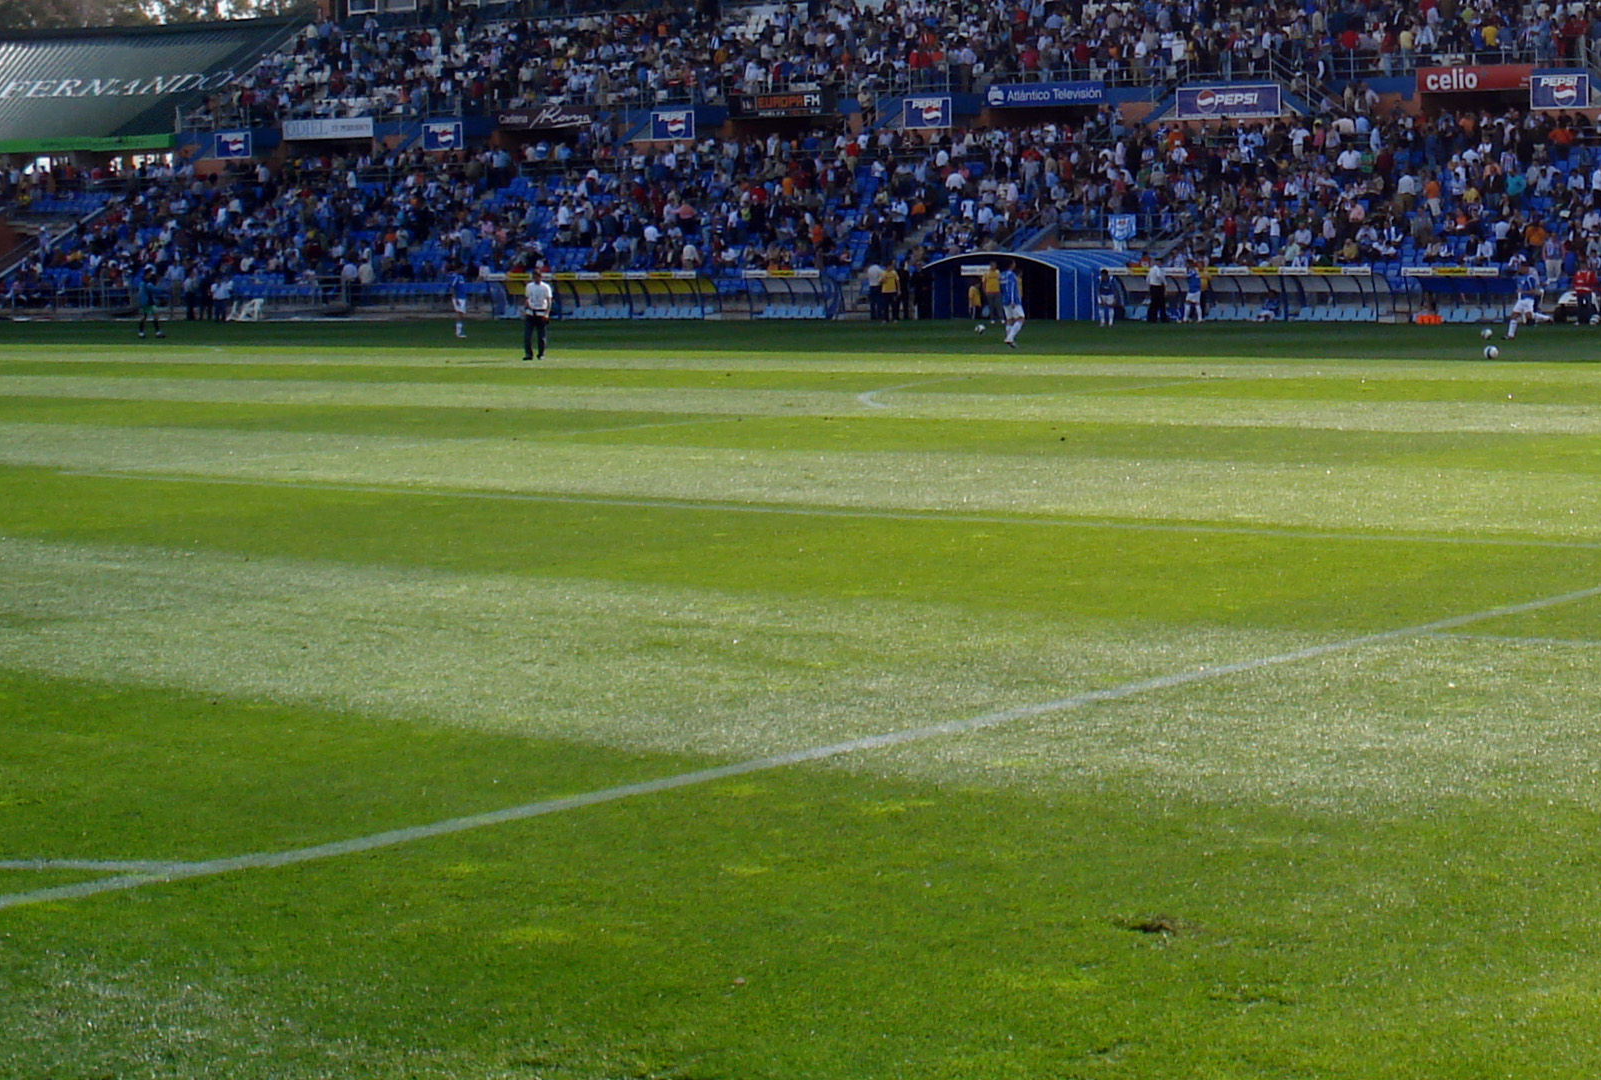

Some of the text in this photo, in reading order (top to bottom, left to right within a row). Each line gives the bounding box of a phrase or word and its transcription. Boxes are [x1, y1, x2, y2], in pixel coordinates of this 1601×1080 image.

[1426, 67, 1478, 90] celio
[1540, 76, 1579, 88] PEPSI
[1006, 85, 1102, 102] Atlántico Televisión
[1213, 93, 1259, 107] PEPSI
[912, 99, 943, 110] PEPSI
[658, 112, 687, 122] PEPSI
